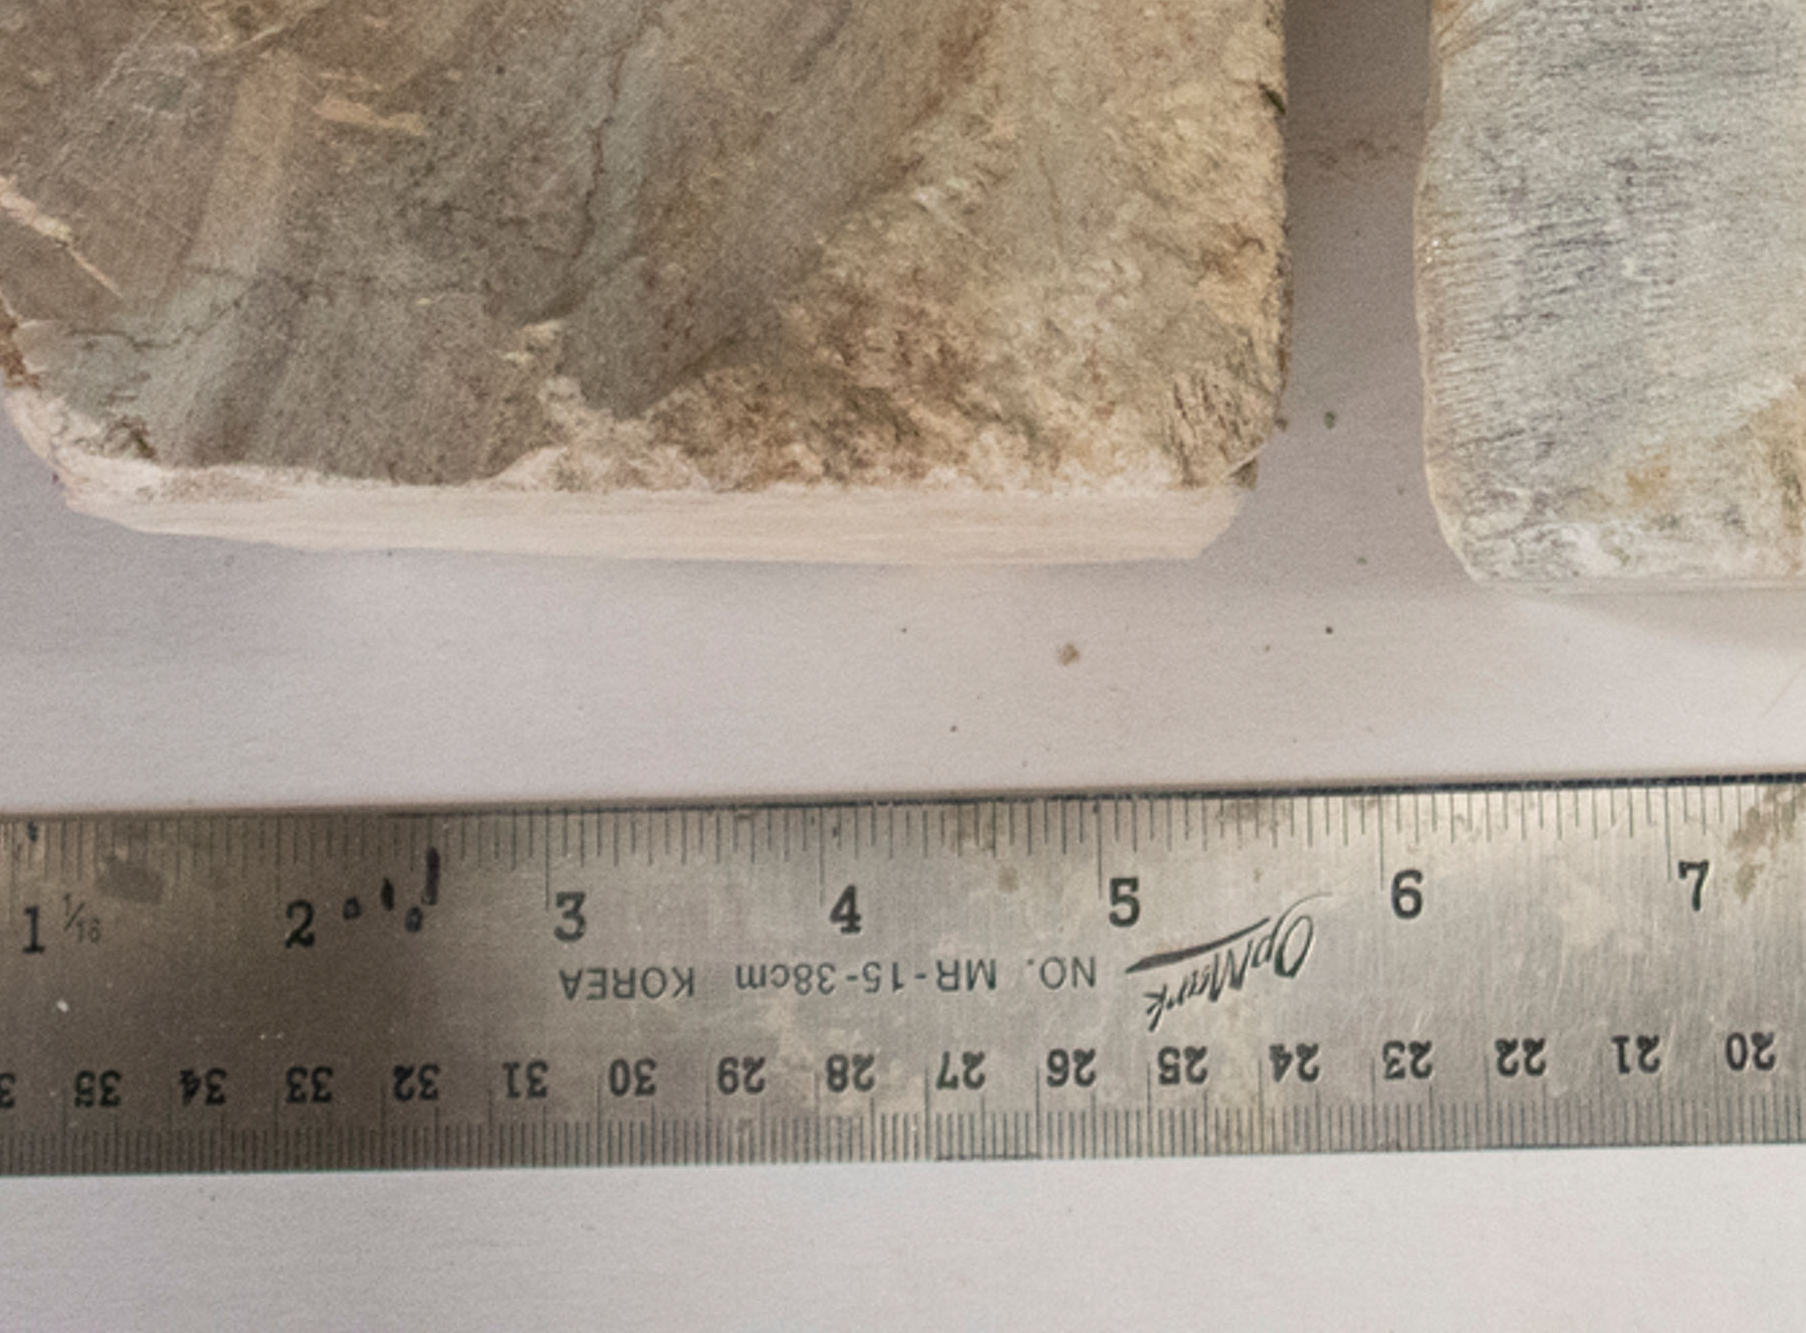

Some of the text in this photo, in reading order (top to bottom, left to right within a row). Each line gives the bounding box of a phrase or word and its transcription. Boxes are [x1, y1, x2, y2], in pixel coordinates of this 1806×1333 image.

[22, 905, 46, 954] 1
[284, 900, 317, 949] 2
[554, 890, 587, 942] 3
[830, 884, 862, 934] 4
[1109, 876, 1141, 928] 5
[1392, 869, 1424, 919] 6
[1679, 859, 1710, 911] 7
[558, 965, 695, 1001] KOREA
[1026, 955, 1096, 990] NO.
[935, 1050, 986, 1092] 27
[1046, 1046, 1097, 1088] 26
[1157, 1044, 1208, 1085] 25
[1269, 1042, 1319, 1083] 24
[1382, 1039, 1433, 1081] 23
[1495, 1037, 1546, 1078] 22
[1611, 1034, 1661, 1075] 21
[1725, 1032, 1776, 1072] 20
[73, 1068, 122, 1109] 35
[179, 1066, 228, 1108] 34
[284, 1064, 334, 1105] 33
[392, 1062, 441, 1103] 32
[501, 1060, 549, 1100] 31
[608, 1057, 657, 1098] 30
[716, 1055, 766, 1096] 29
[825, 1053, 875, 1094] 28
